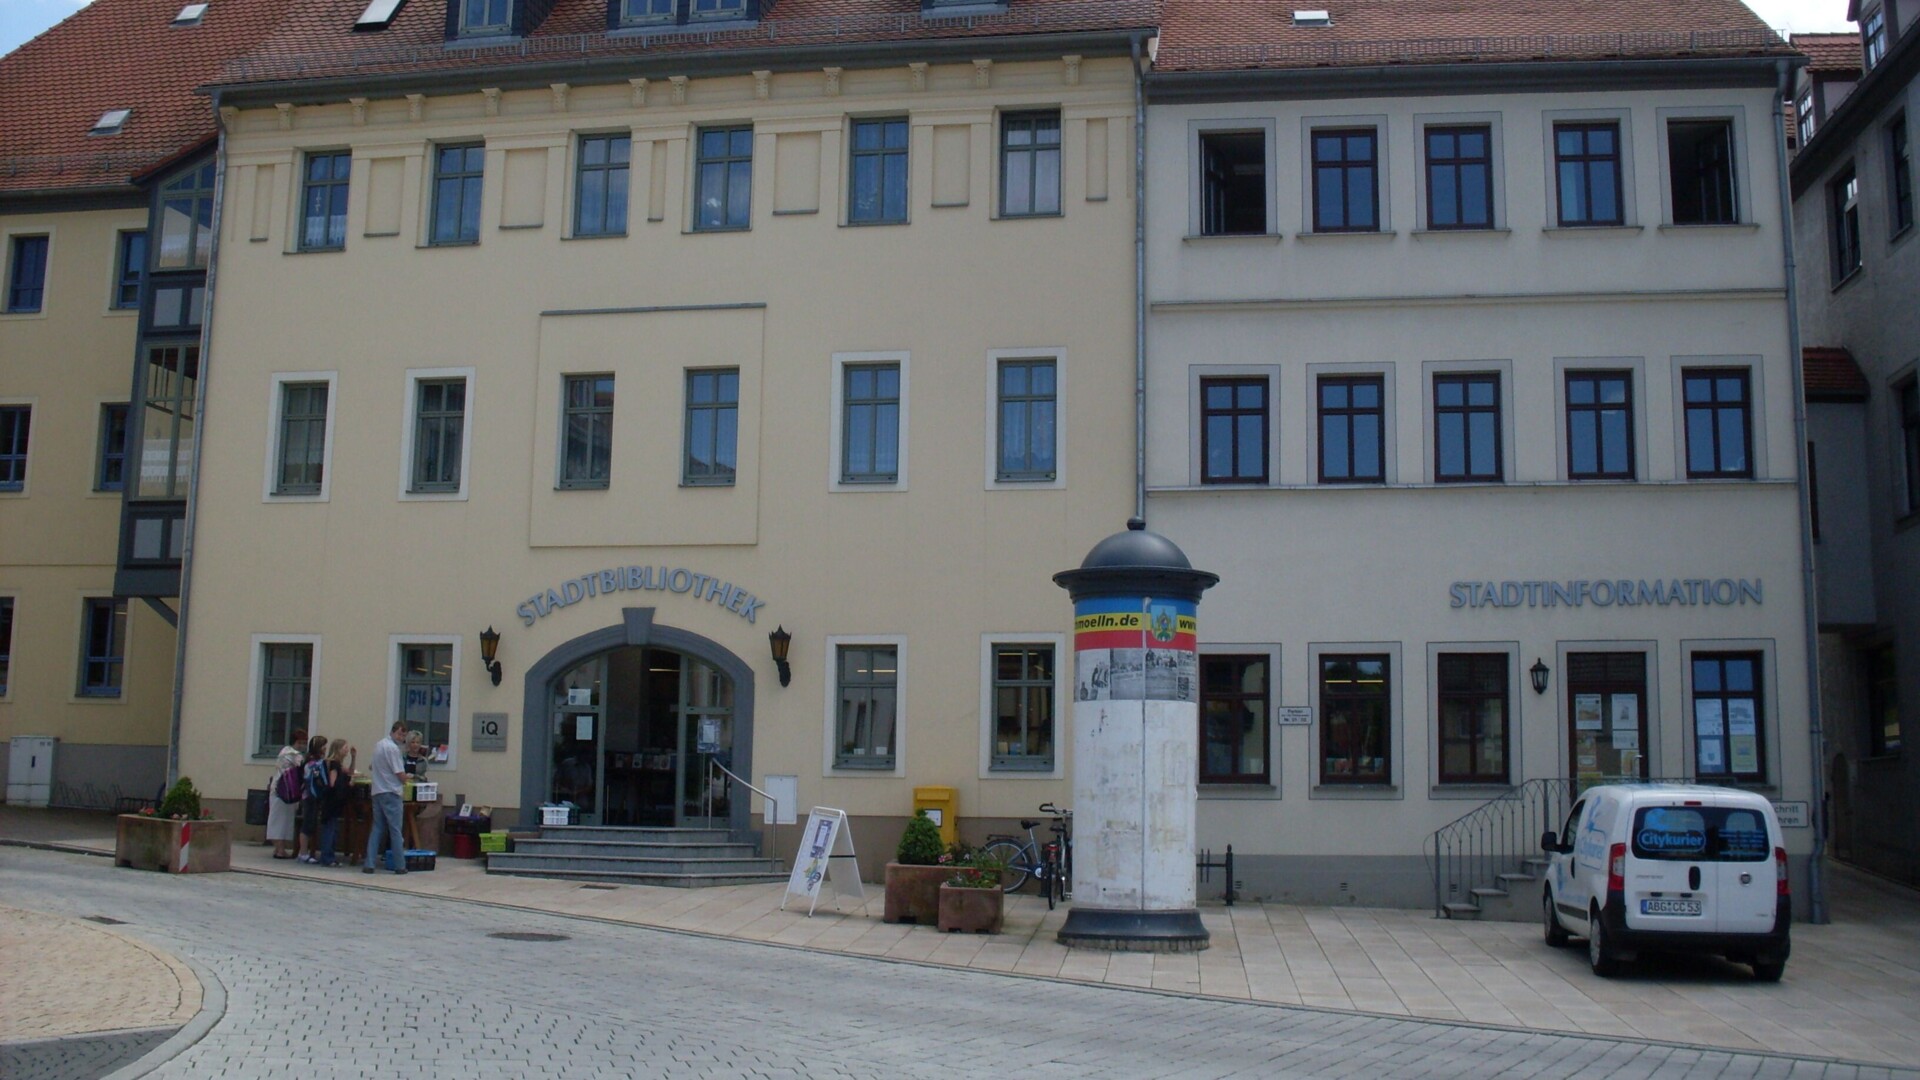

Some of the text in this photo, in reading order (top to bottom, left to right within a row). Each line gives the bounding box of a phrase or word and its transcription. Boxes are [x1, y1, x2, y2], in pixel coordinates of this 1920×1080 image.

[517, 566, 765, 627] STADTBIBLIOTHEK
[1449, 578, 1763, 608] STADTINFORMATION
[481, 720, 498, 736] iQ
[1775, 805, 1799, 813] chritt
[1778, 816, 1799, 824] hren
[1641, 833, 1703, 848] Citykurier
[1648, 902, 1700, 912] ABG CC 53
